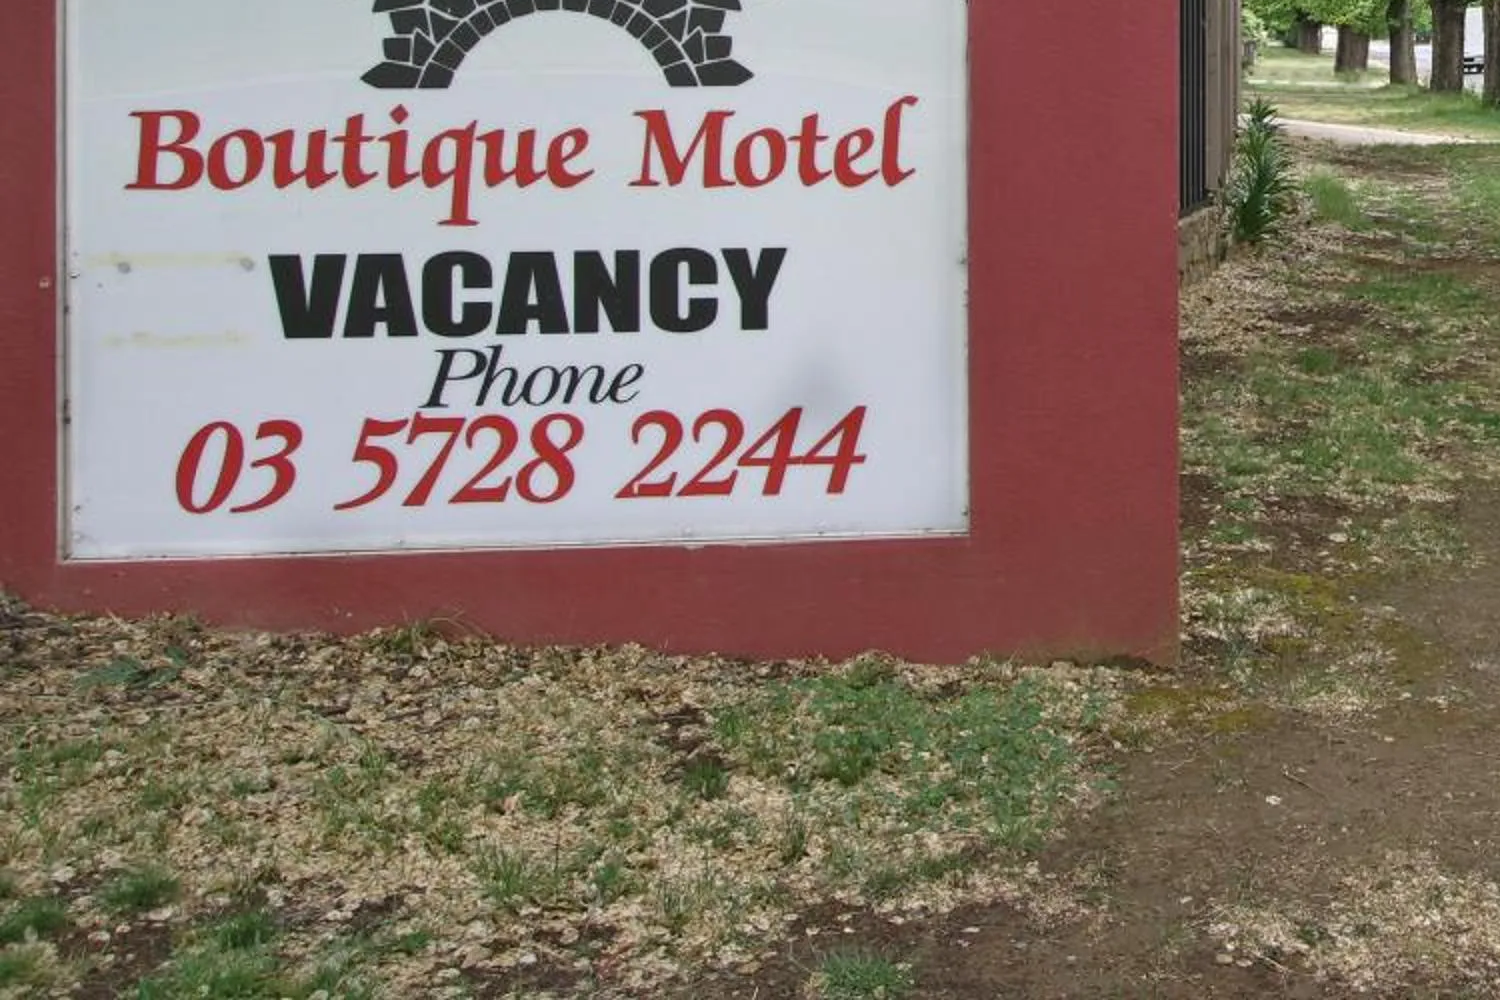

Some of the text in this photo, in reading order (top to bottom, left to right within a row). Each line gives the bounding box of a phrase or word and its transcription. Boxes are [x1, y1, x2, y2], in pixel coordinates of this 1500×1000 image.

[122, 95, 919, 227] Boutique Motel
[267, 247, 788, 340] VACANCY
[417, 343, 645, 409] Phone
[174, 405, 868, 514] 03 5728 2244
